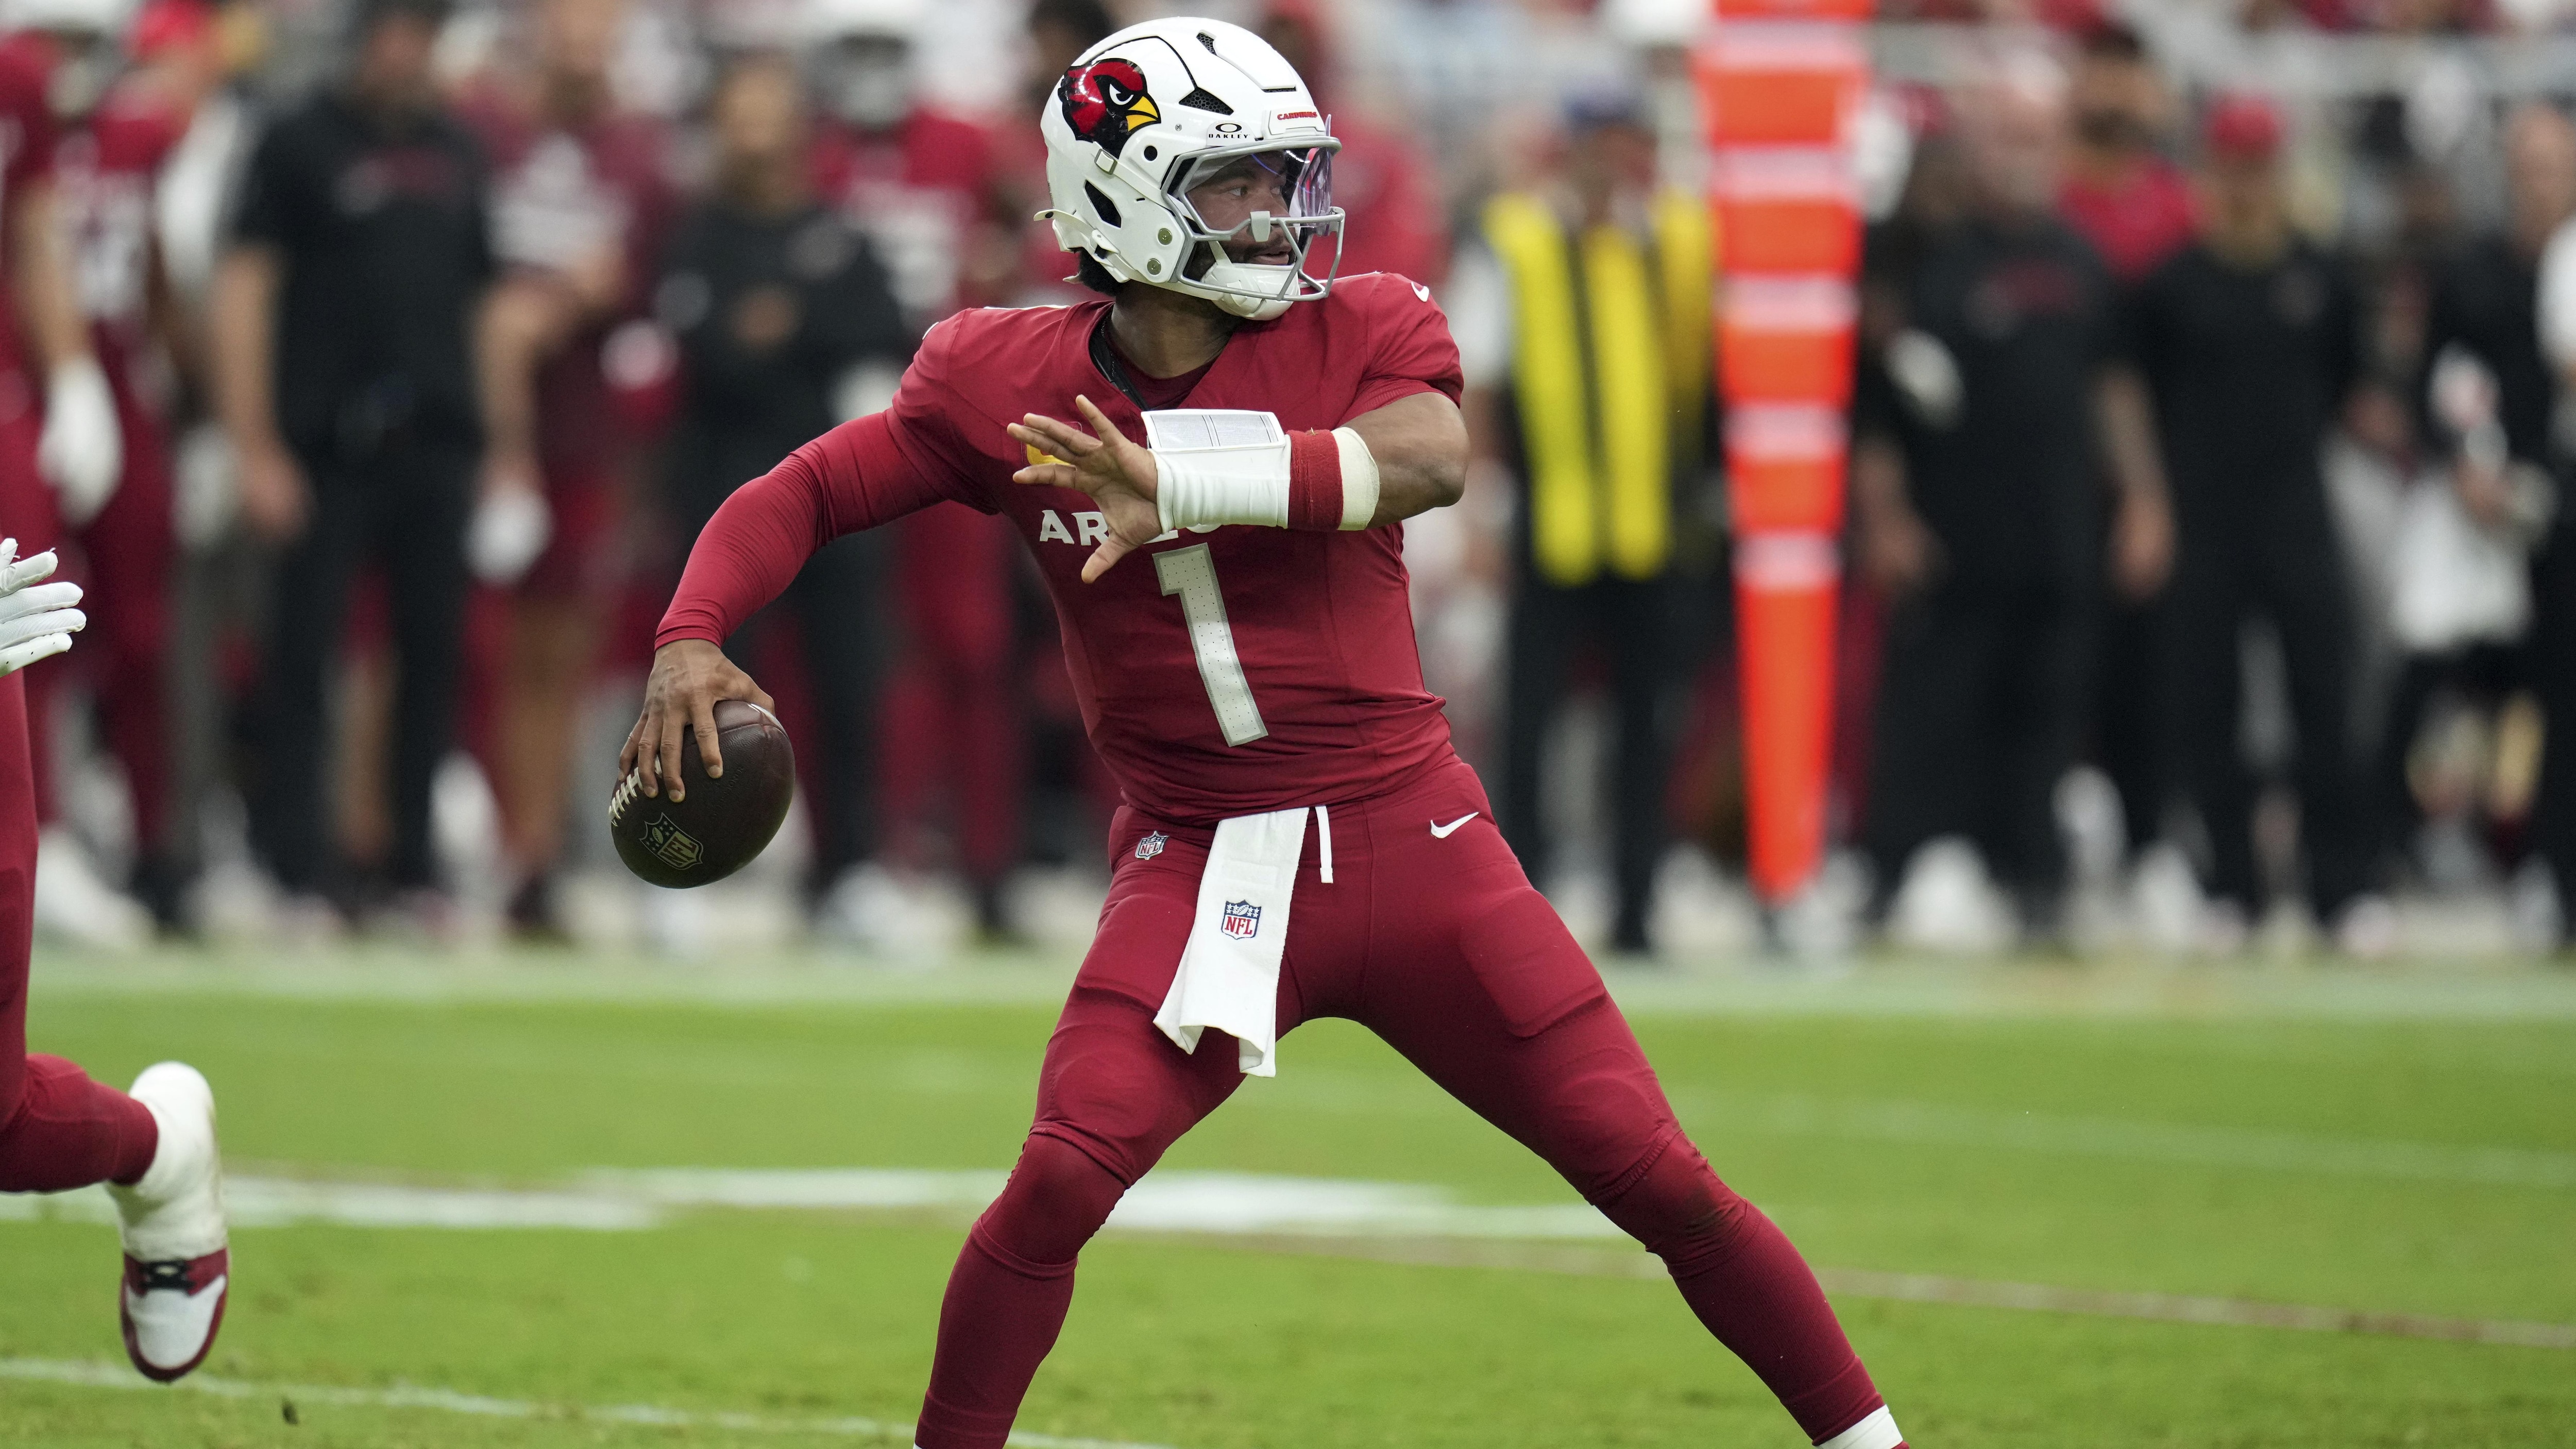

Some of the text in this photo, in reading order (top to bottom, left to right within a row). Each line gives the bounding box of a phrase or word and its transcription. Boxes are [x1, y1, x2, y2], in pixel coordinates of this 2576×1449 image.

[1152, 542, 1268, 747] 1
[659, 836, 697, 866] NFL
[1140, 843, 1159, 854] NFL
[1225, 916, 1252, 935] NFL
